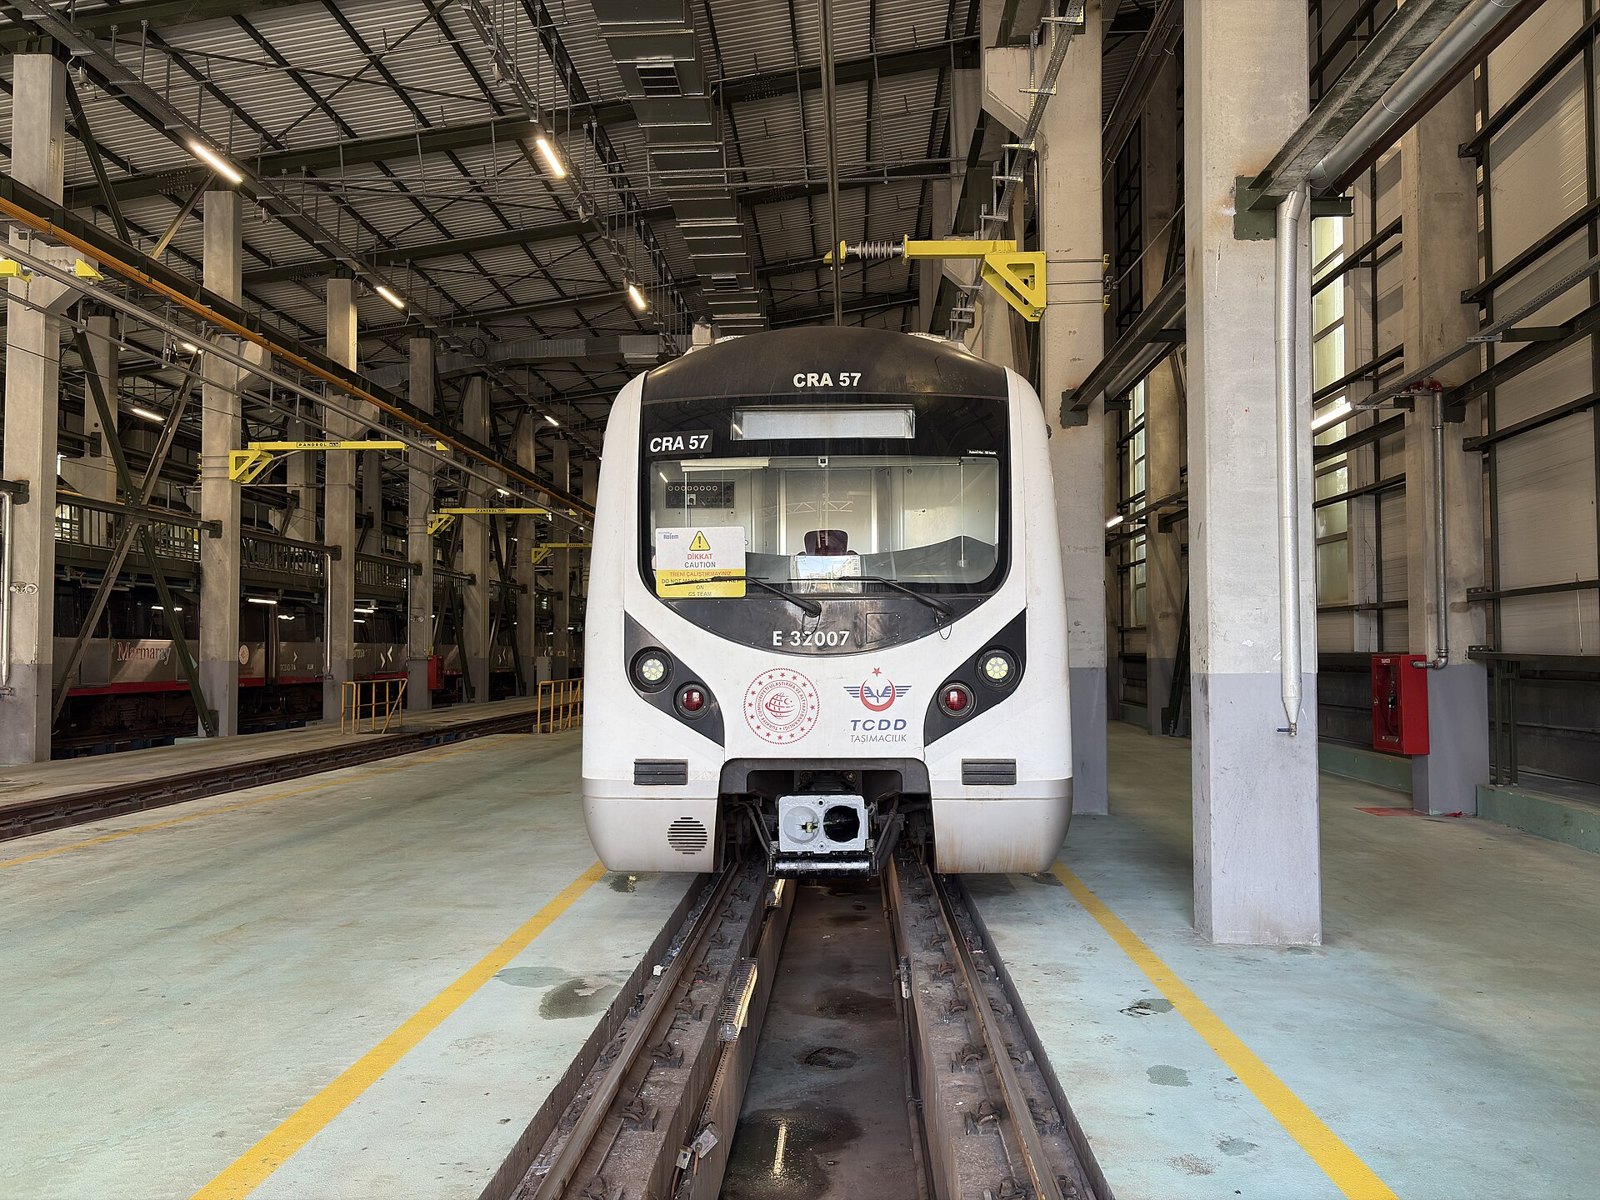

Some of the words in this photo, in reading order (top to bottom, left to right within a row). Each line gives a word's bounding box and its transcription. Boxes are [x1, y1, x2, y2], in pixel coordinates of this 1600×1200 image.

[793, 373, 833, 388] CRA
[839, 373, 862, 387] 57
[650, 437, 684, 453] CRA
[689, 435, 710, 451] 57
[684, 561, 716, 569] CAUTION
[773, 631, 782, 646] E
[790, 631, 850, 646] 32007
[117, 641, 171, 666] Marmaray
[851, 719, 907, 731] TCDD
[850, 733, 907, 743] TAŞIMACILIK
